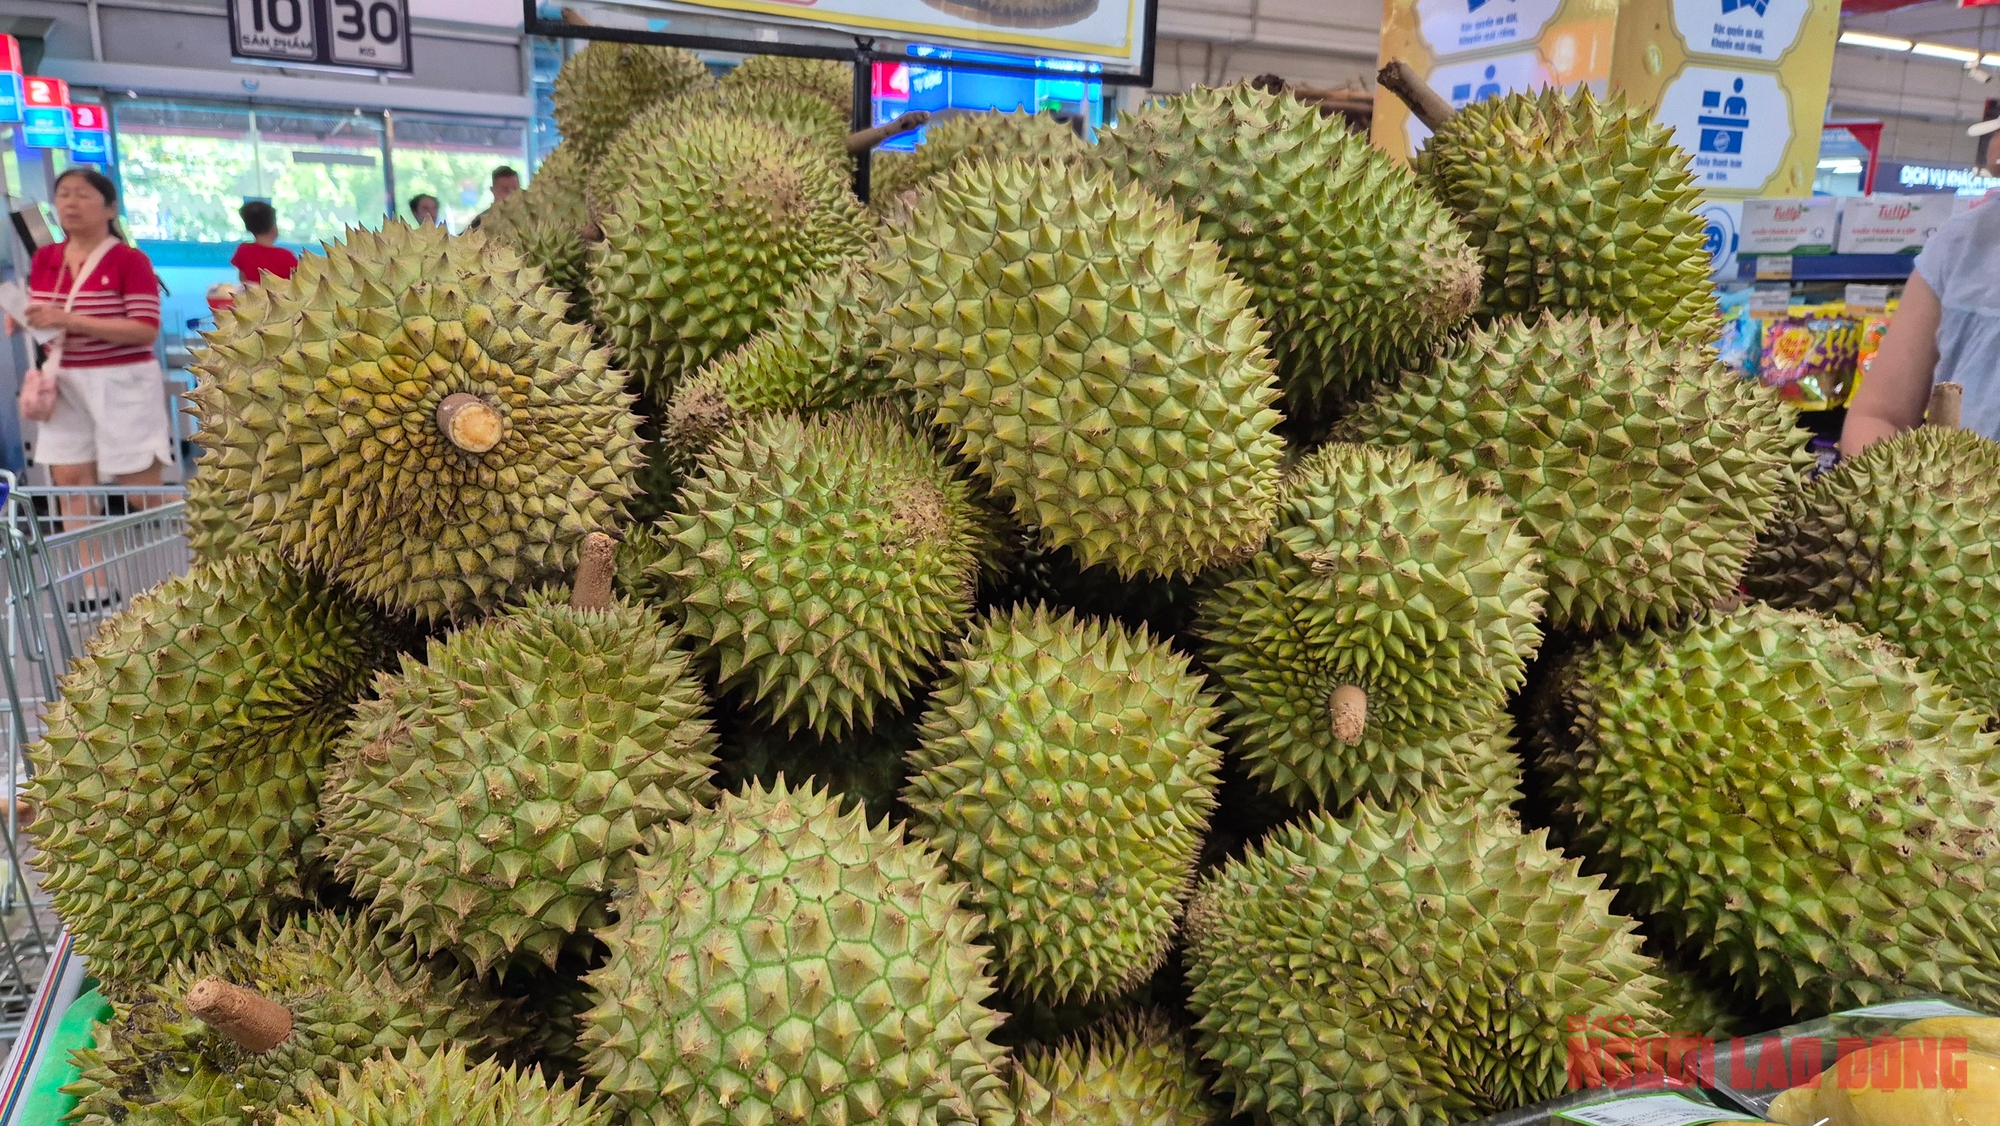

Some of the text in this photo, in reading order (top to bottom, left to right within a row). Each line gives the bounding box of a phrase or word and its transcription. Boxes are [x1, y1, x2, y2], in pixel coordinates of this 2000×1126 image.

[252, 0, 302, 34] 10
[334, 0, 398, 44] 30
[358, 47, 376, 57] KG
[30, 80, 51, 103] 2
[77, 107, 95, 126] 3
